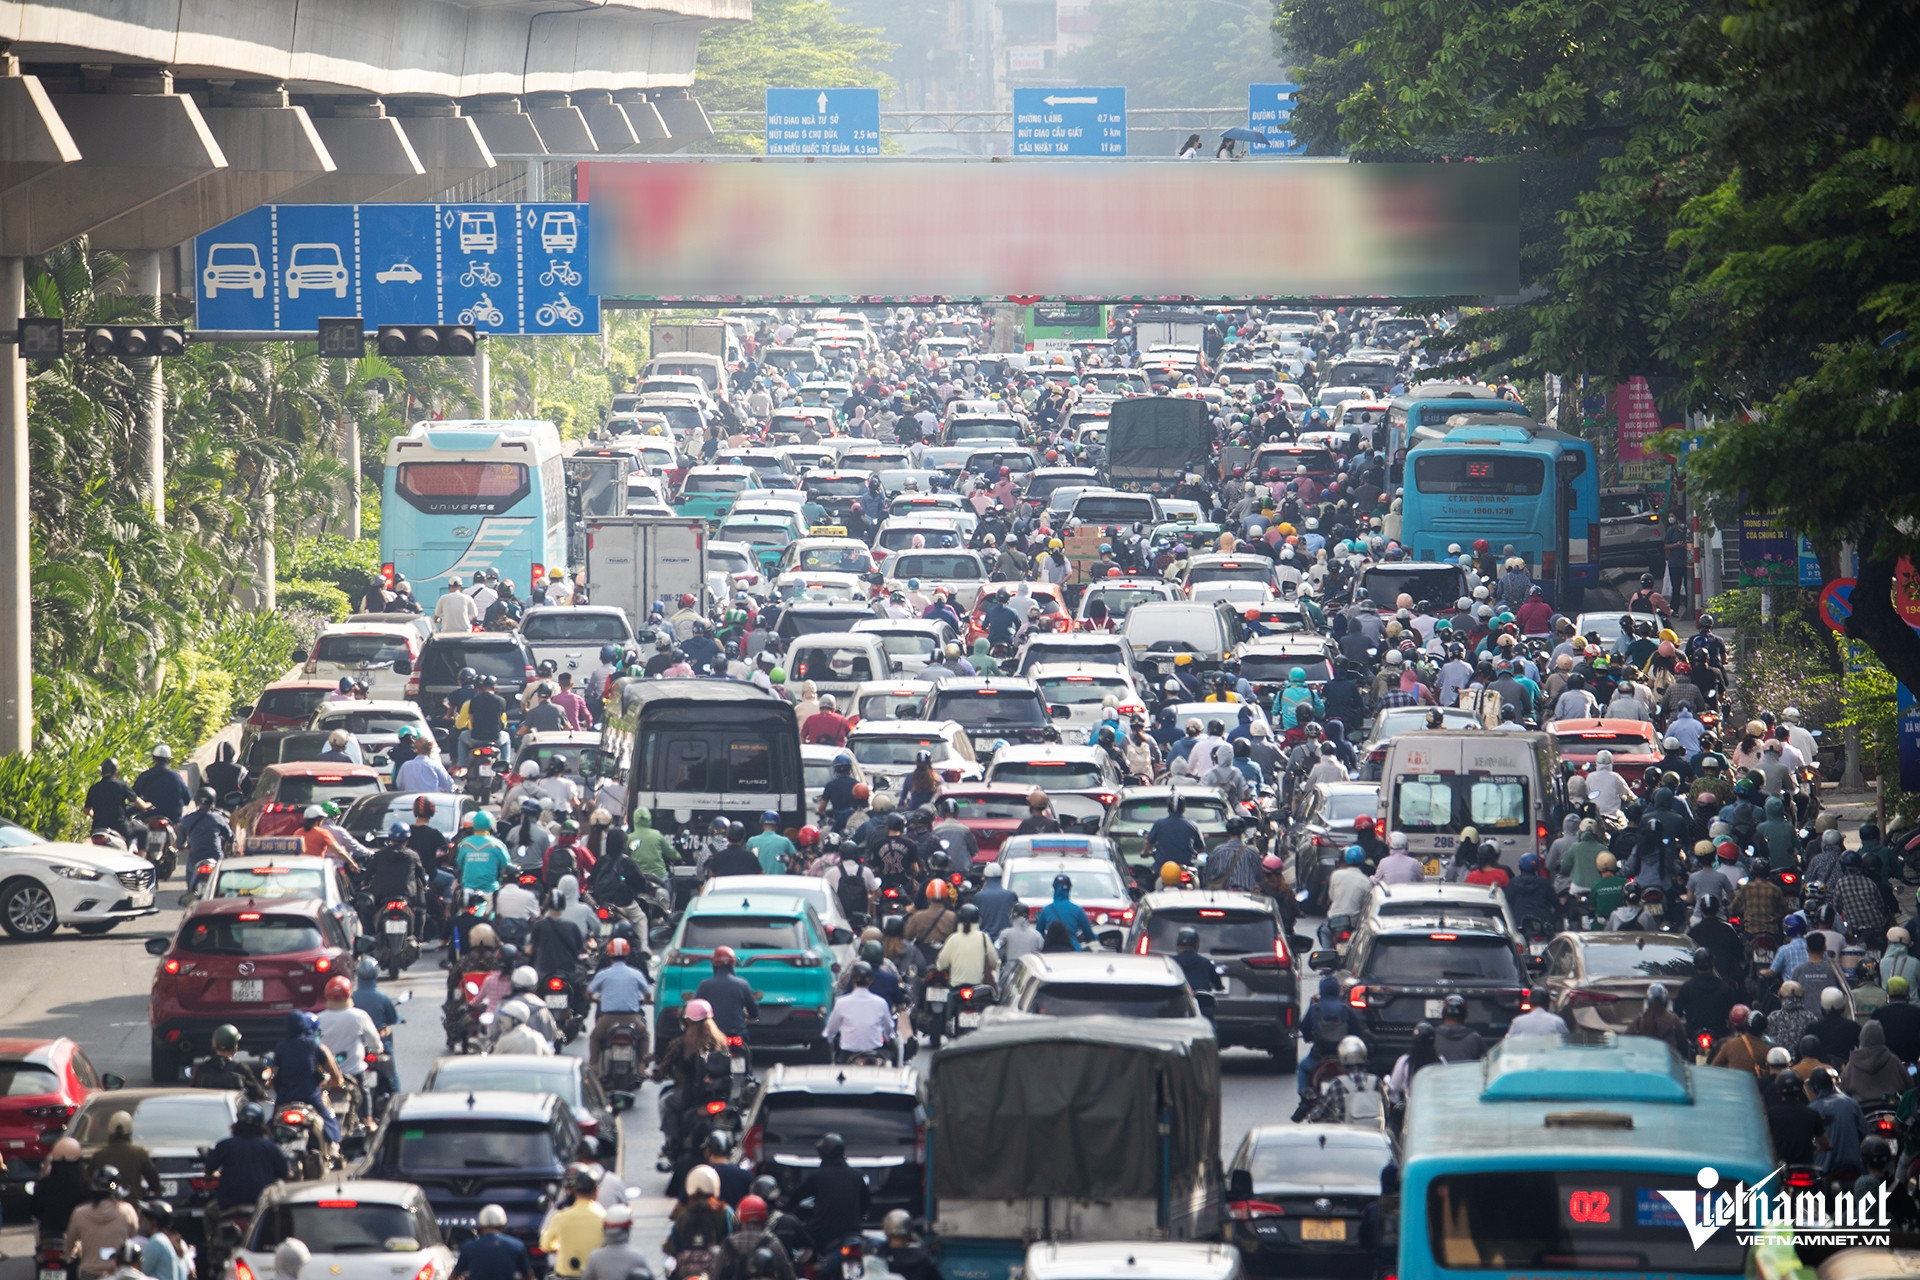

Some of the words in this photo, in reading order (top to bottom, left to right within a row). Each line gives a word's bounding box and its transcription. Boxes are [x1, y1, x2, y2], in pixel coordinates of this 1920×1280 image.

[784, 116, 800, 125] GIAO
[1109, 114, 1120, 122] km
[784, 130, 800, 139] GIAO
[854, 130, 865, 139] 2.5
[867, 130, 878, 139] km
[1034, 129, 1050, 138] GIAO
[1103, 129, 1108, 137] 5
[1109, 128, 1121, 137] km
[867, 145, 878, 153] km
[1109, 143, 1121, 152] km
[1743, 519, 1761, 528] TRONG
[1570, 1190, 1611, 1223] 02
